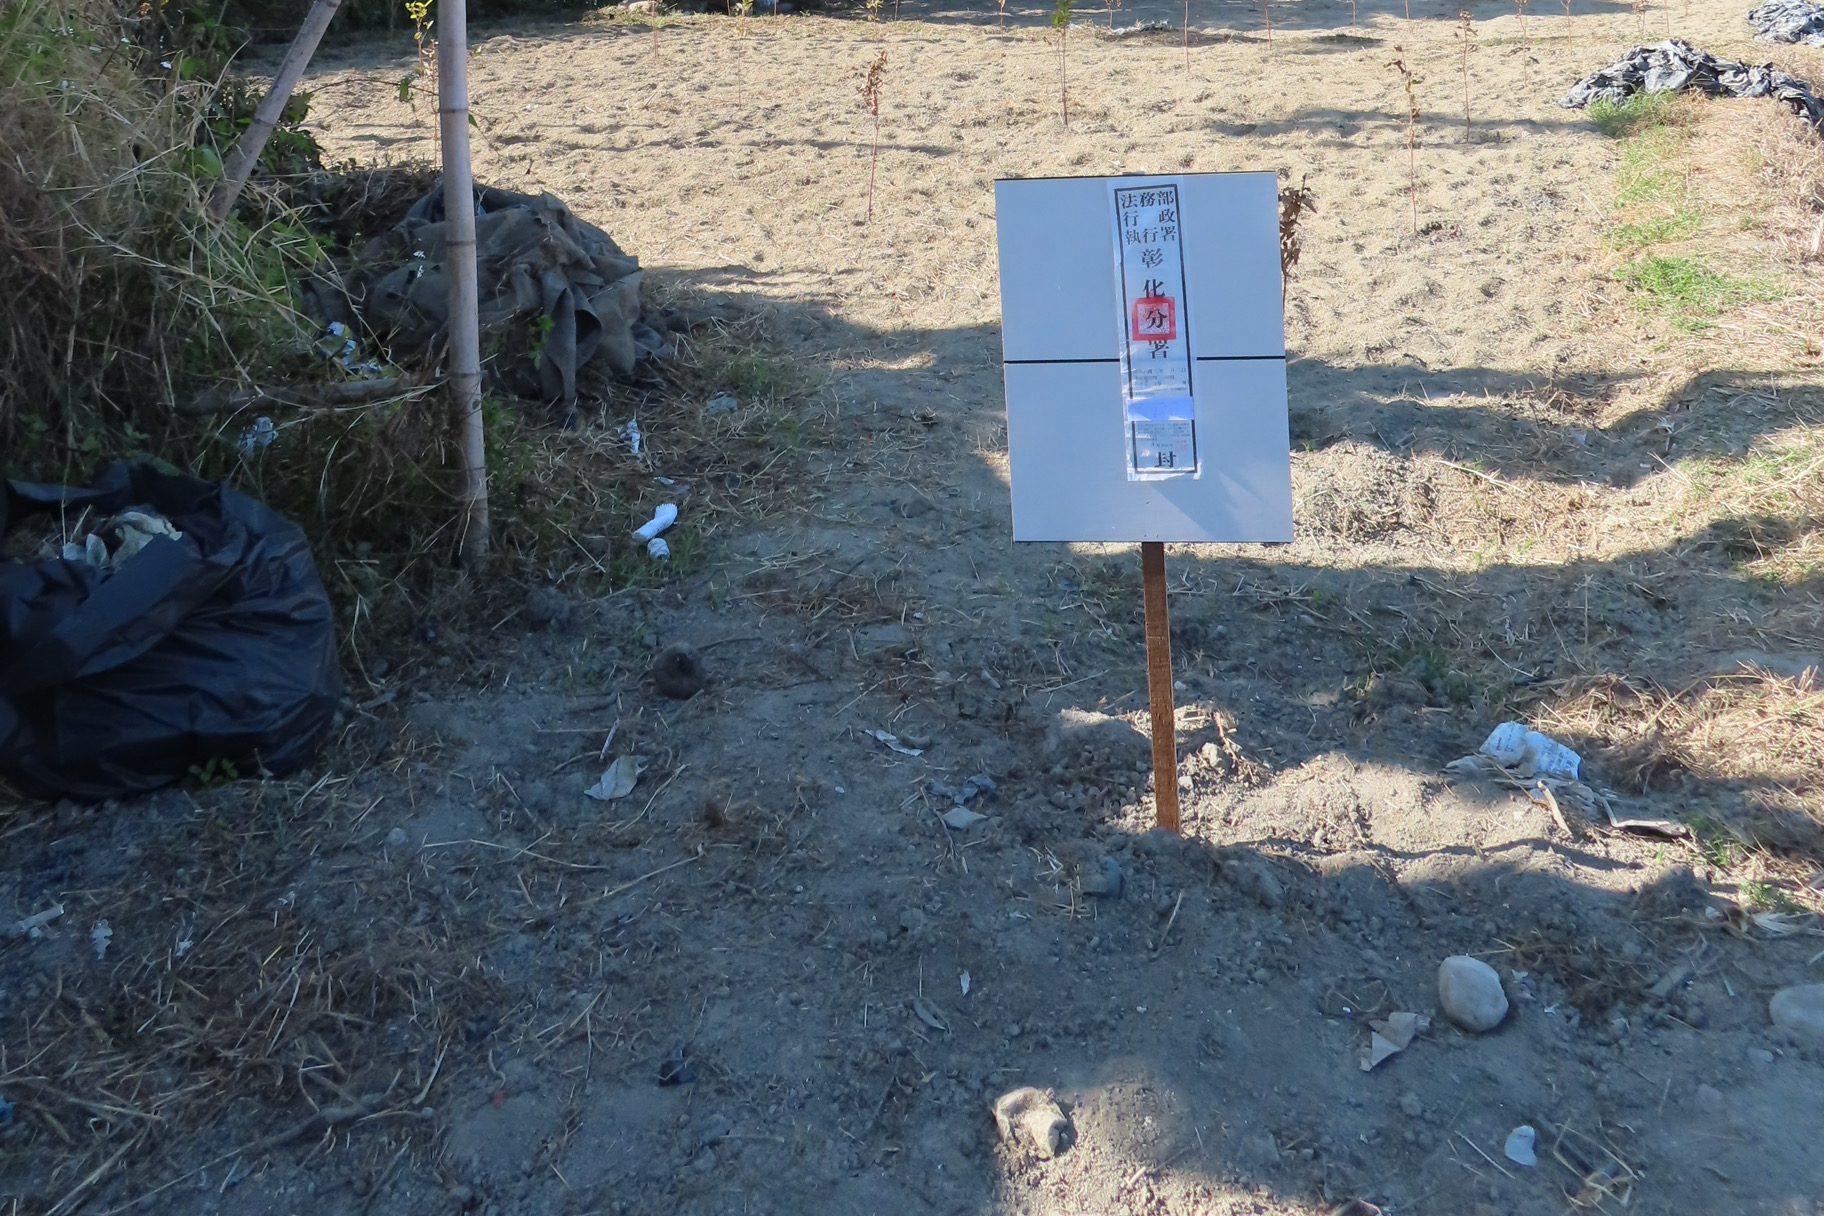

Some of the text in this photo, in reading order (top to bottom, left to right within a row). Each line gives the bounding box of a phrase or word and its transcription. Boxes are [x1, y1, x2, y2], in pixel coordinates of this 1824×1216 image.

[1120, 190, 1175, 210] 法務部
[1122, 208, 1176, 228] 行政
[1125, 225, 1177, 246] 執行署
[1140, 247, 1170, 360] 彰化分署
[1154, 450, 1177, 468] 封
